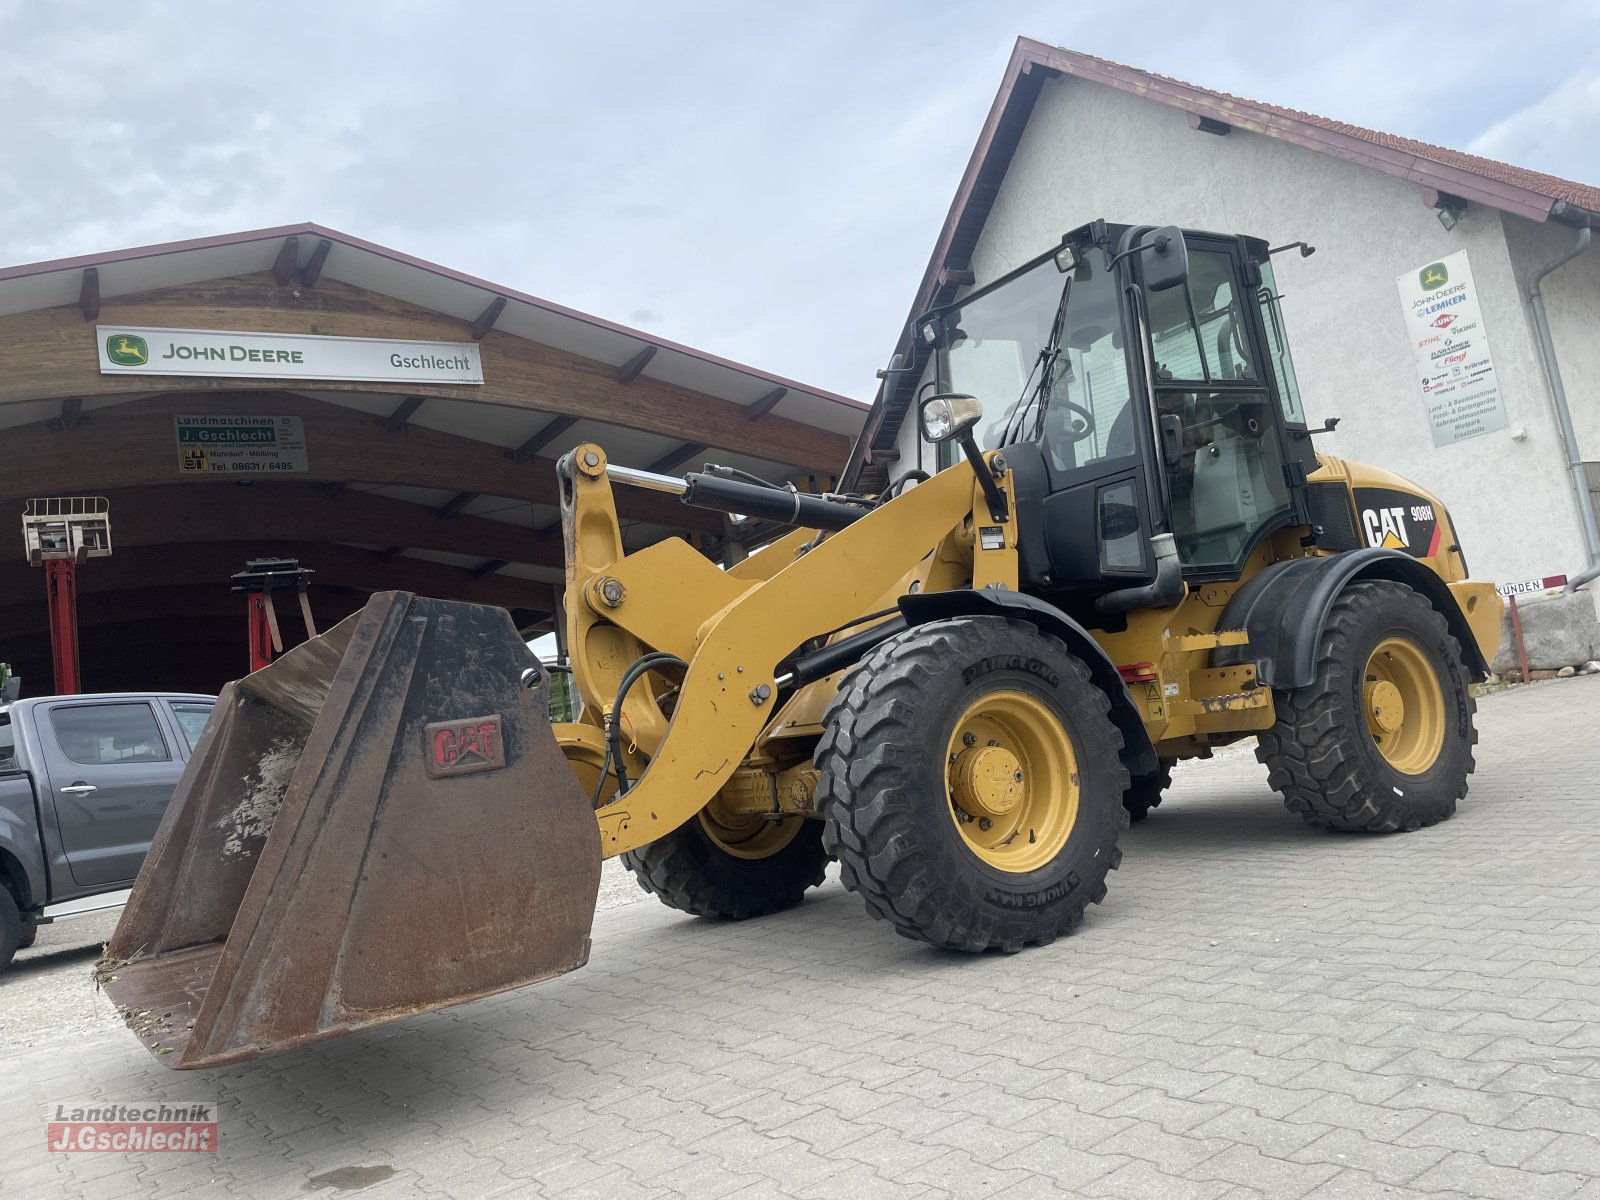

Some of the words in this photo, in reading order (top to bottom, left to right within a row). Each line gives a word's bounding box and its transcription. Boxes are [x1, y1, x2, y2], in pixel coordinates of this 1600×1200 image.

[1411, 295, 1435, 309] JOHN
[1436, 282, 1467, 299] DEERE
[1425, 293, 1466, 315] LEMKEN
[1432, 315, 1456, 327] KUHN
[1451, 322, 1477, 335] VIKING
[1418, 335, 1441, 348] STIHL
[162, 343, 225, 361] JOHN
[230, 345, 304, 364] DEERE
[390, 353, 471, 371] Gschlecht
[1444, 351, 1467, 365] Fliegl
[177, 416, 274, 425] Landmaschinen
[183, 430, 195, 441] J.
[199, 430, 273, 441] Gschlecht
[210, 463, 229, 471] Tel.
[269, 462, 293, 470] 6495
[1362, 507, 1410, 548] CAT
[1410, 505, 1434, 522] 908H
[434, 724, 498, 769] CAT
